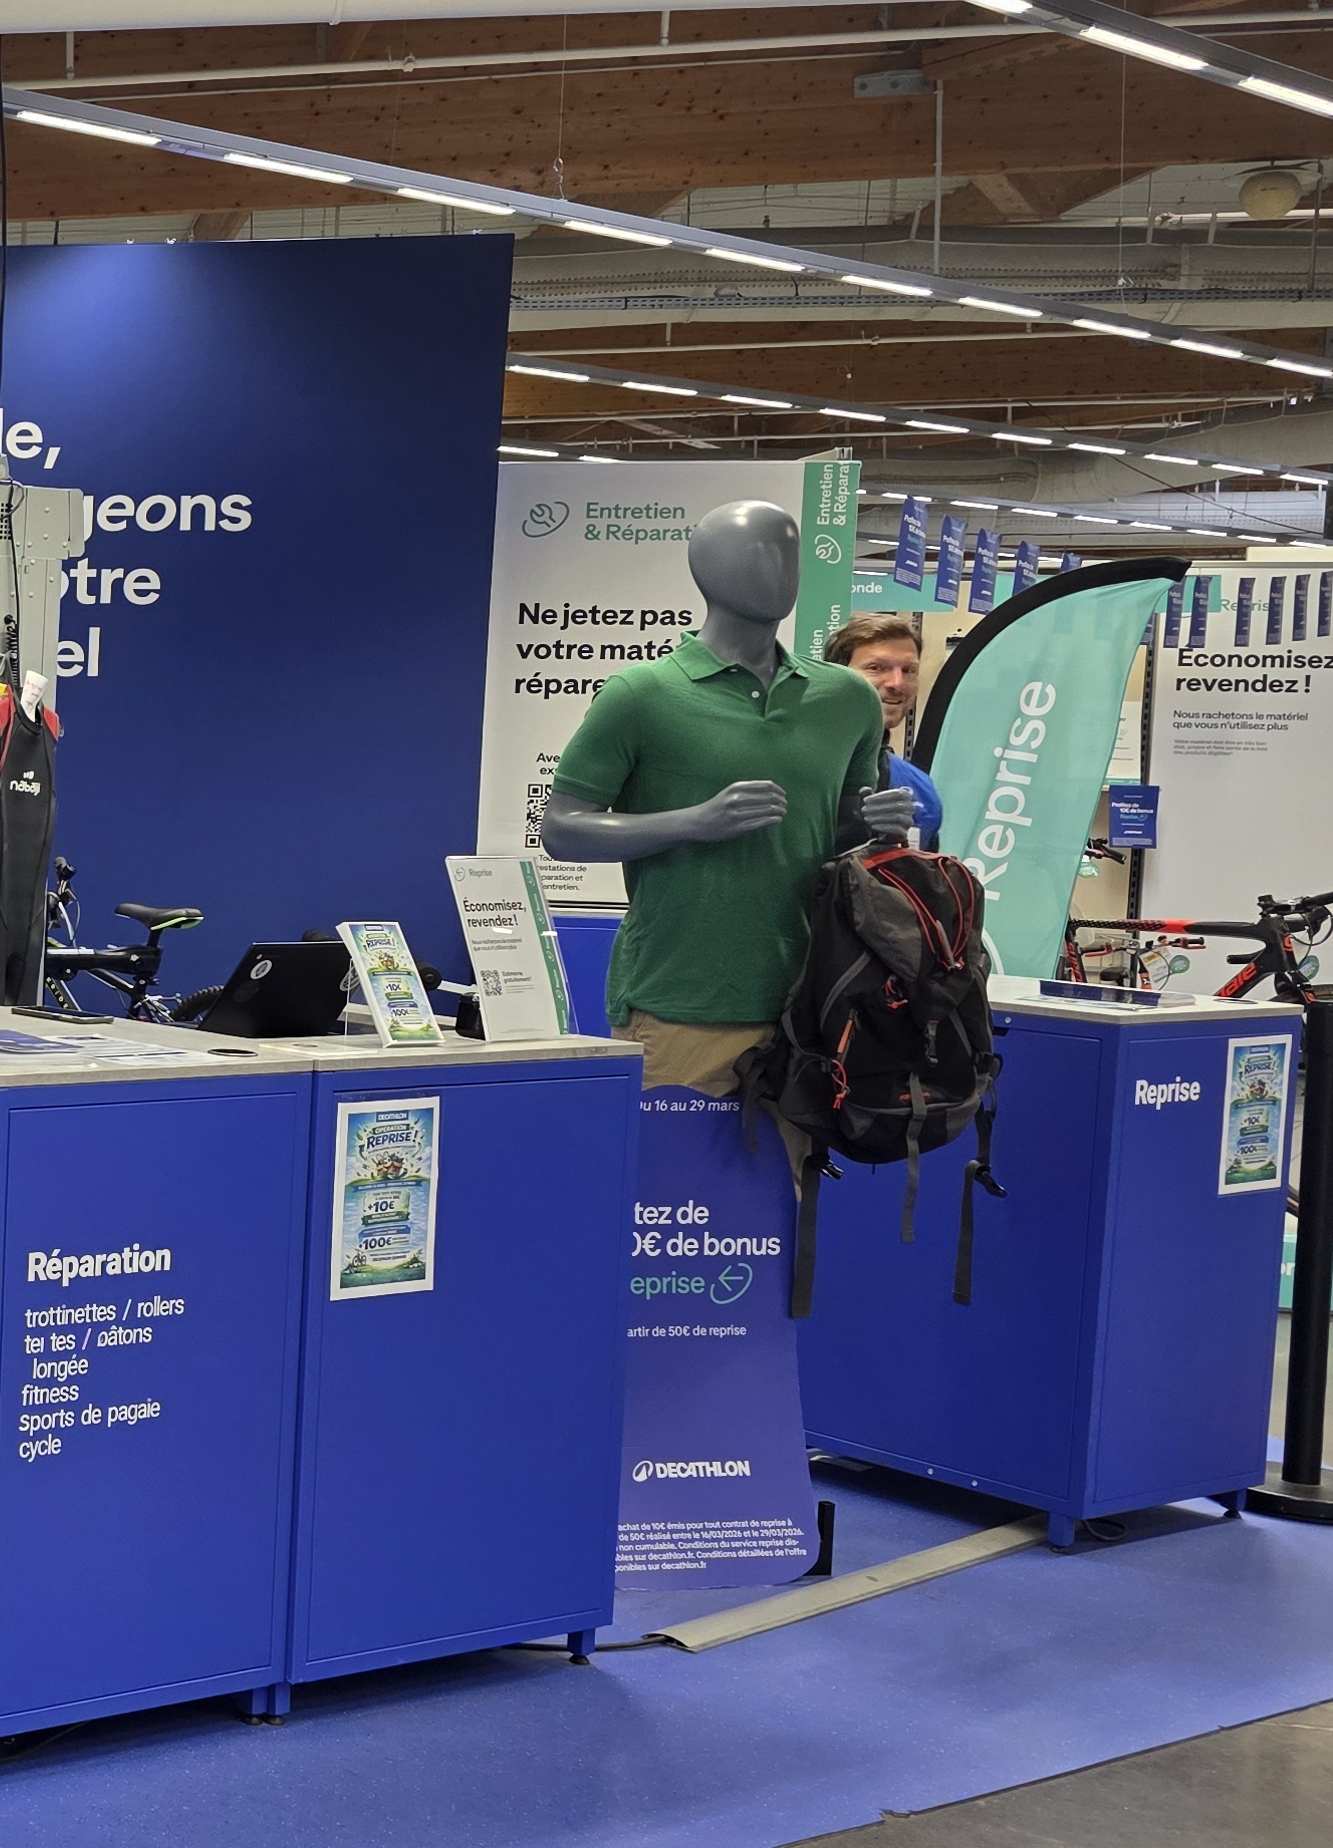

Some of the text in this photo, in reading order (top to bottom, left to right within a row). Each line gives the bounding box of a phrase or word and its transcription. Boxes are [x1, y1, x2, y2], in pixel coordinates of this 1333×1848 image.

[817, 464, 833, 525] Entretien
[586, 502, 685, 519] Entretien
[584, 524, 698, 544] & Réparat
[518, 603, 692, 631] Ne jetez pas
[516, 639, 674, 660] votre maté
[1175, 674, 1298, 693] revendez
[1173, 710, 1308, 721] Nous rachetons le matériel
[1173, 722, 1193, 730] que
[1267, 722, 1288, 731] plus
[962, 681, 1056, 901] Reprise
[463, 897, 526, 912] Économisez,
[1135, 1076, 1200, 1110] Reprise
[654, 1100, 740, 1111] 16 au 29 mars
[367, 1132, 412, 1149] REPRISE
[368, 1201, 395, 1212] +10€
[677, 1200, 709, 1225] de
[666, 1232, 780, 1256] de bonus
[27, 1243, 171, 1287] Réparation
[25, 1295, 185, 1328] trottinettes rollers
[651, 1325, 747, 1338] de 50€ de reprise
[33, 1354, 88, 1382] longée
[22, 1384, 79, 1406] fitness
[19, 1398, 160, 1436] sports de pagaie
[19, 1434, 61, 1462] cycle
[655, 1460, 751, 1479] DECATHLON
